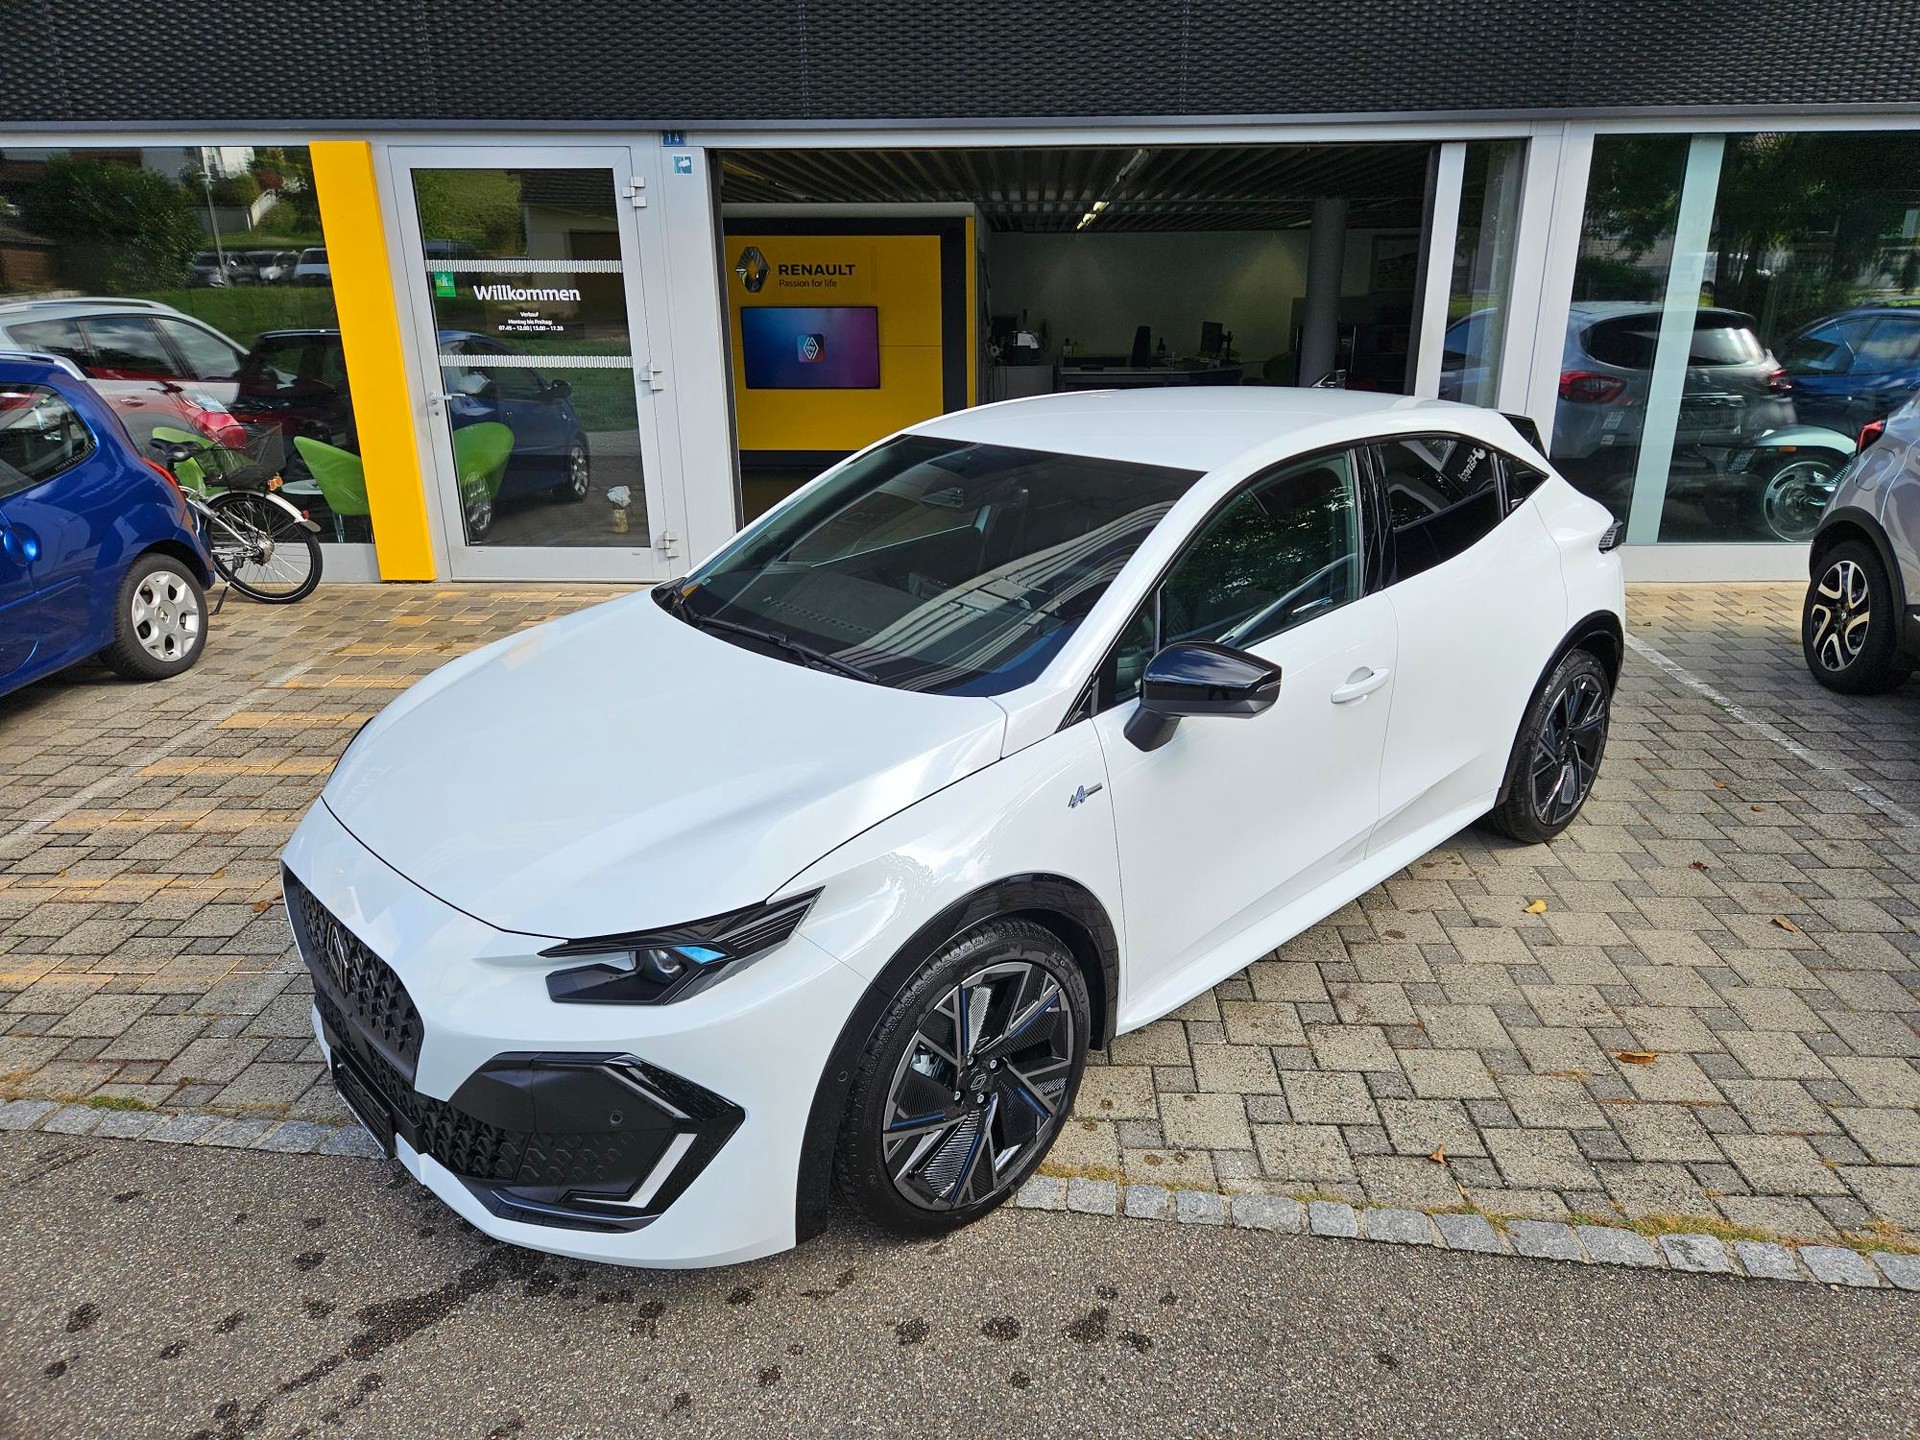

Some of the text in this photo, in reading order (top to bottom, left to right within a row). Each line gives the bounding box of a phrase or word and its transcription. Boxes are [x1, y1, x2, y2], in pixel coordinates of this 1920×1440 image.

[667, 133, 680, 143] 14
[778, 264, 856, 276] RENAULT
[779, 279, 838, 288] Passion for life
[473, 285, 581, 301] Willkommen
